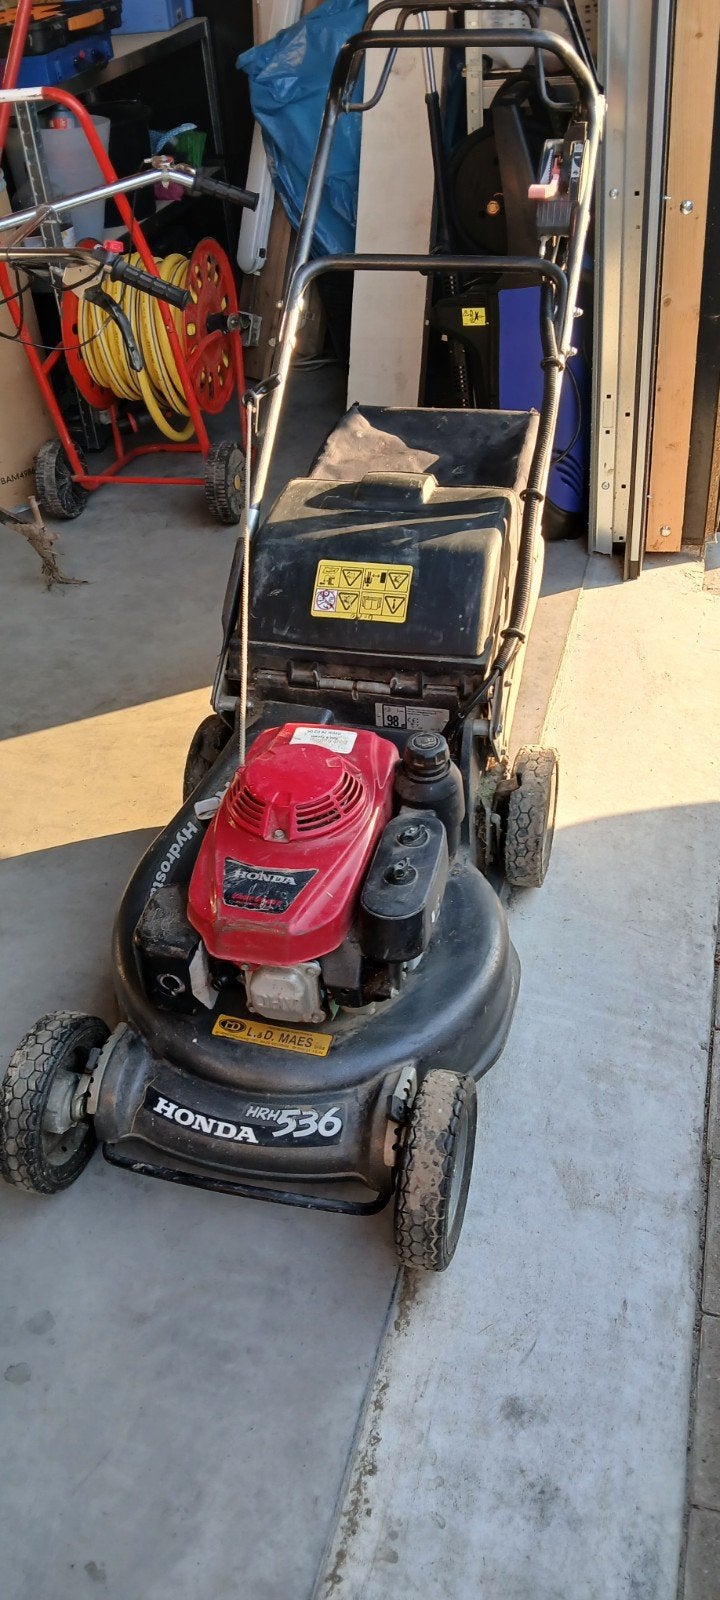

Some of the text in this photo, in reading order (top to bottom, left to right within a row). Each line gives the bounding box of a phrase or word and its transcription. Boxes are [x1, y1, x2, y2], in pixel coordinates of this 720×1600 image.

[386, 714, 399, 727] 98
[232, 868, 297, 885] HONDA
[278, 1033, 314, 1048] MAES
[152, 1096, 259, 1144] HONDA
[245, 1105, 342, 1138] HRH 536
